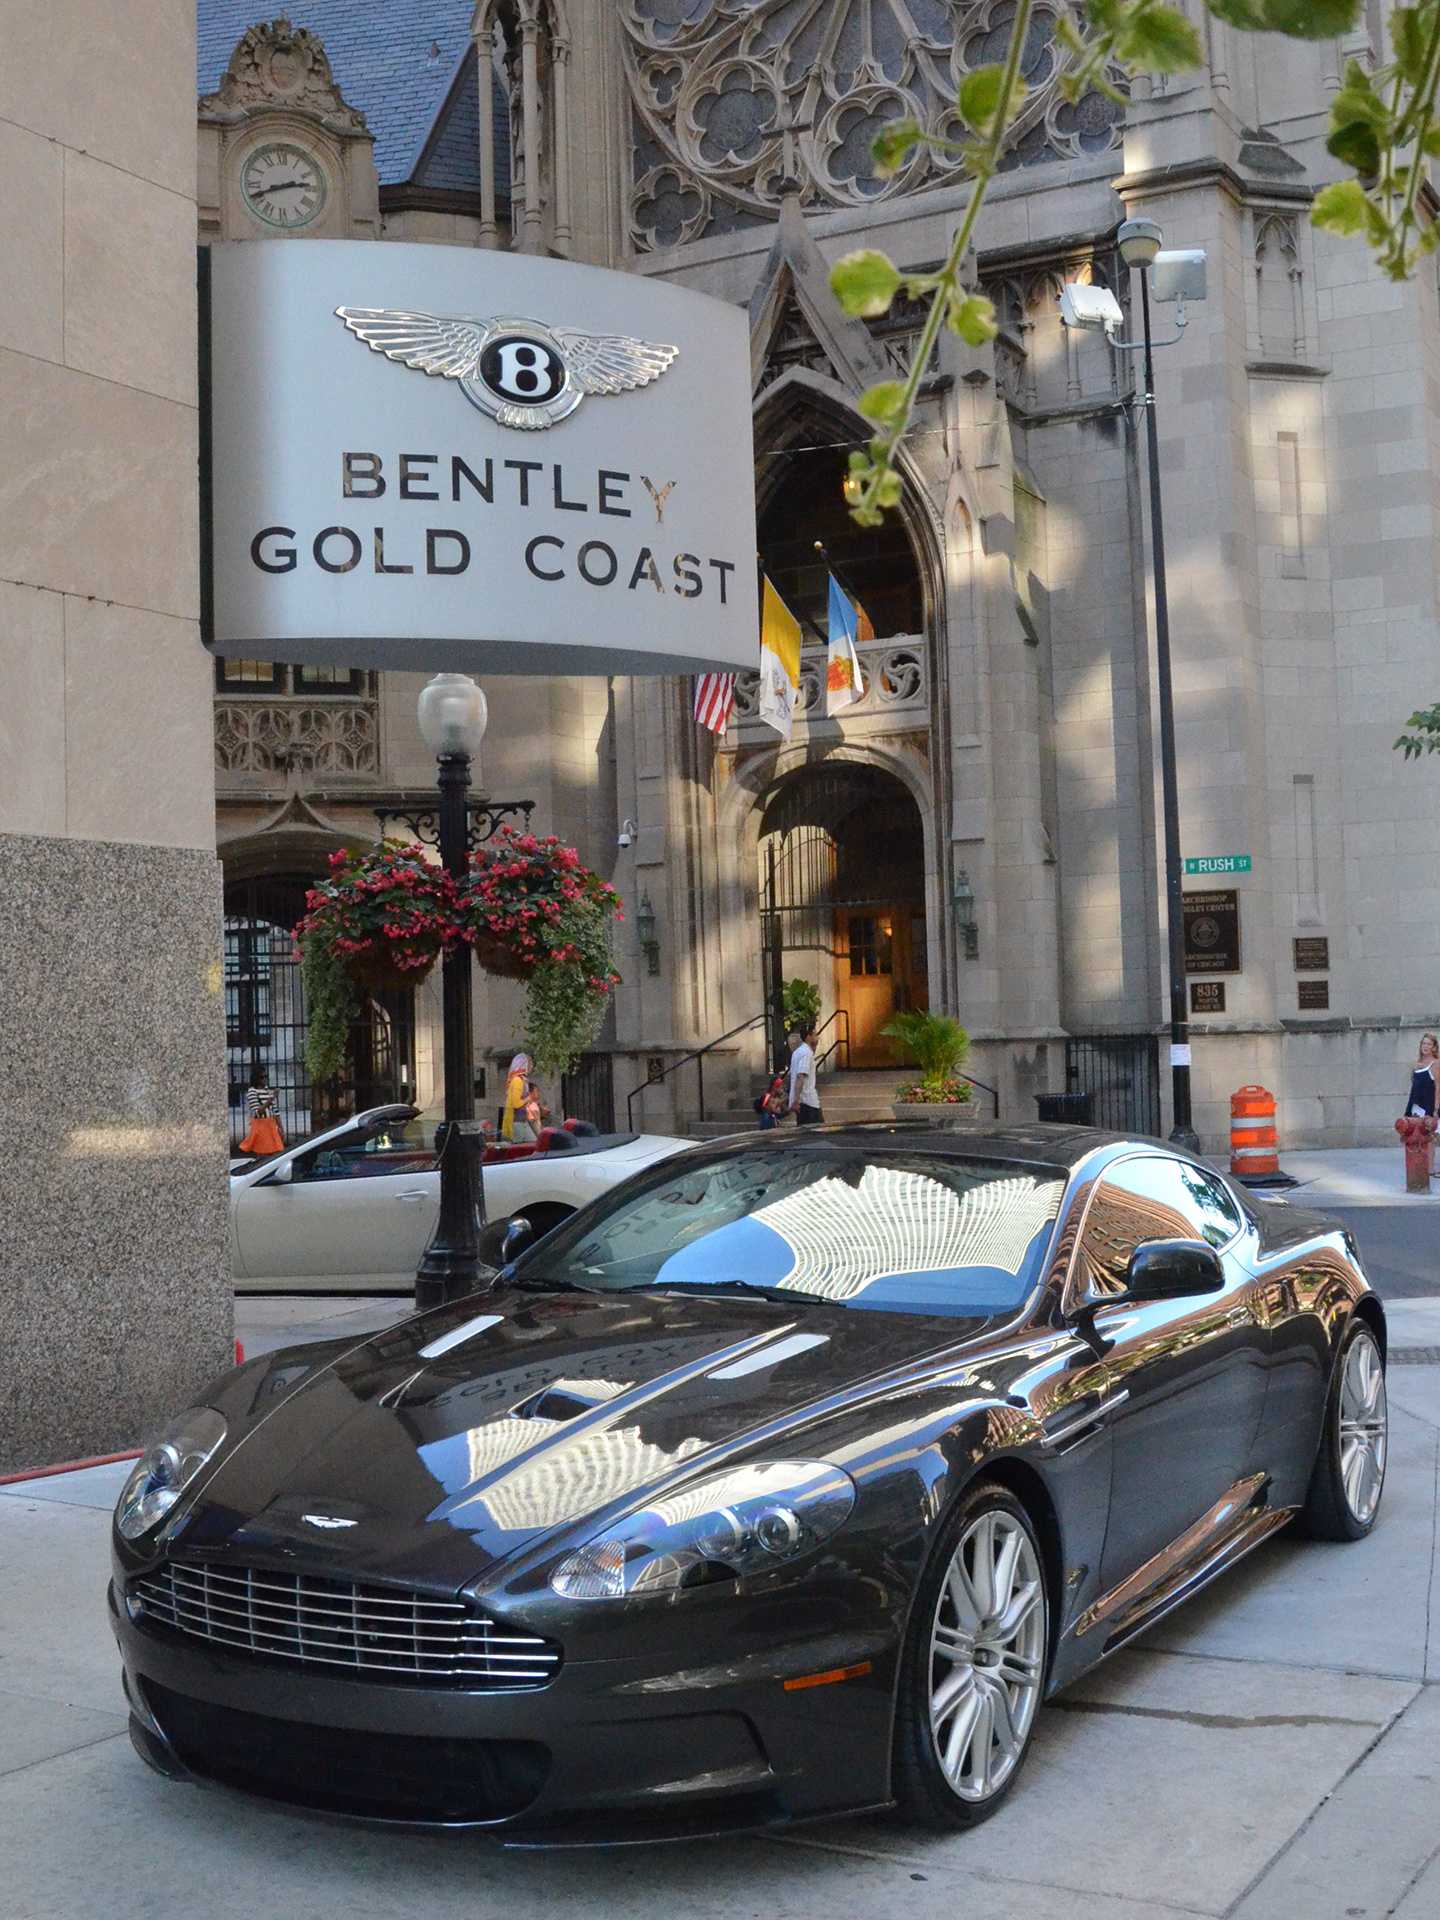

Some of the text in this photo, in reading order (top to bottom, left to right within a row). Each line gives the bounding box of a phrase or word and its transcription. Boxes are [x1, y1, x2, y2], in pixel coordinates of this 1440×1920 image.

[498, 342, 552, 397] B
[342, 451, 677, 524] BENTLEY
[250, 526, 736, 604] GOLD COAST
[1198, 857, 1234, 873] RUSH
